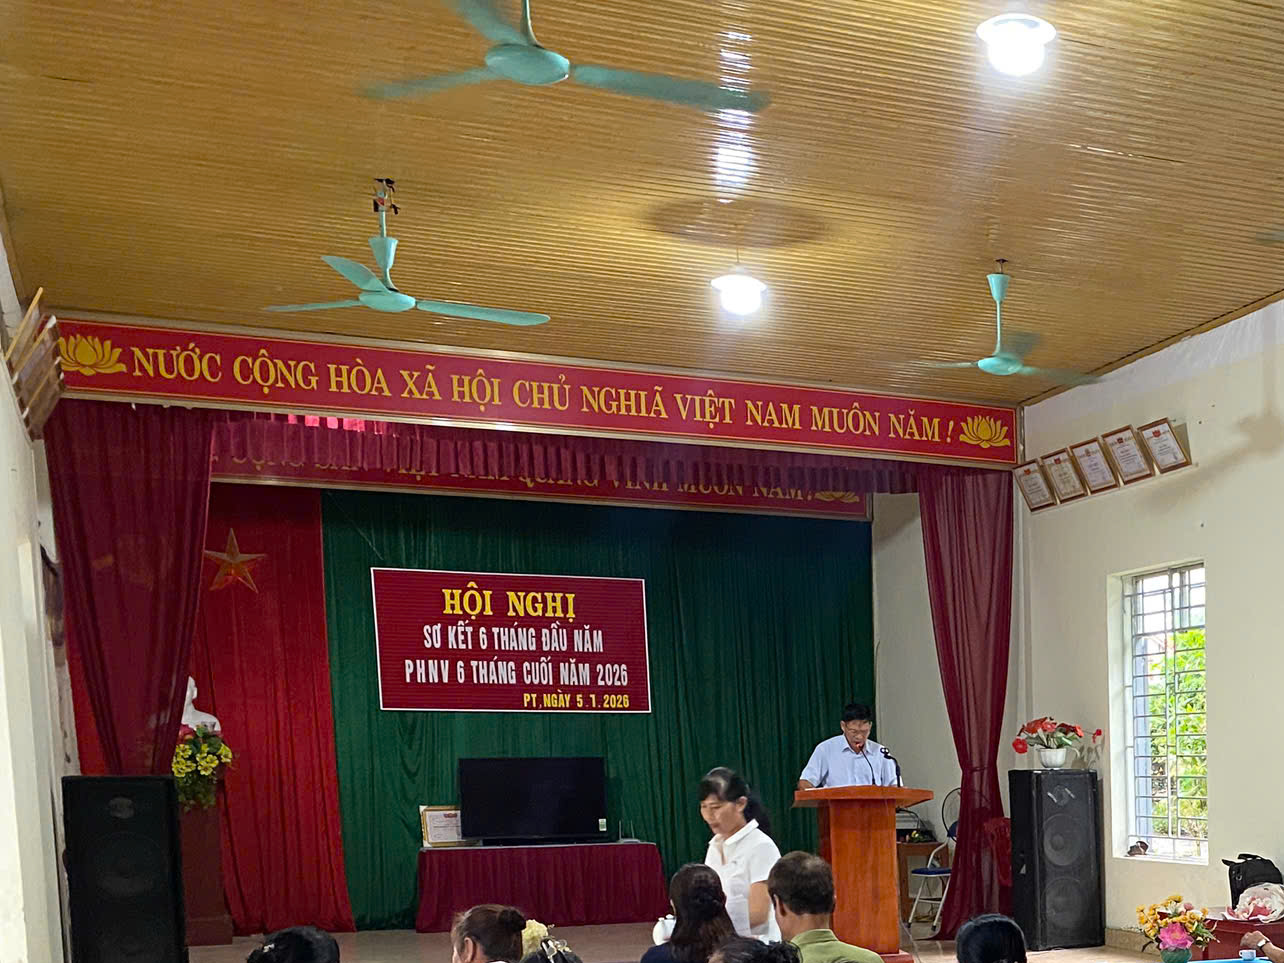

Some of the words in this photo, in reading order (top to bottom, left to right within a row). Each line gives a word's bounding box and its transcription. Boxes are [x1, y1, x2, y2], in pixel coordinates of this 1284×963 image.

[130, 342, 222, 382] NƯỚC
[233, 349, 318, 394] CỘNG
[327, 358, 392, 396] HÒA
[400, 364, 442, 400] XÃ
[450, 369, 502, 412] HỘI
[512, 373, 571, 411] CHỦ
[674, 389, 736, 429] VIỆT
[745, 399, 802, 430] NAM
[810, 402, 880, 436] MUÔN
[442, 582, 494, 620] HỘI
[506, 591, 576, 623] NGHỊ
[424, 622, 442, 648] SƠ
[448, 620, 473, 650] KẾT
[479, 626, 488, 650] 6
[492, 622, 536, 651] THÁNG
[542, 620, 568, 651] ĐẦU
[574, 624, 604, 652] NĂM
[404, 659, 450, 684] PHNV
[456, 660, 465, 684] 6
[470, 656, 517, 685] THÁNG
[523, 656, 554, 686] CUỐI
[560, 658, 590, 686] NĂM
[596, 664, 628, 686] 2026
